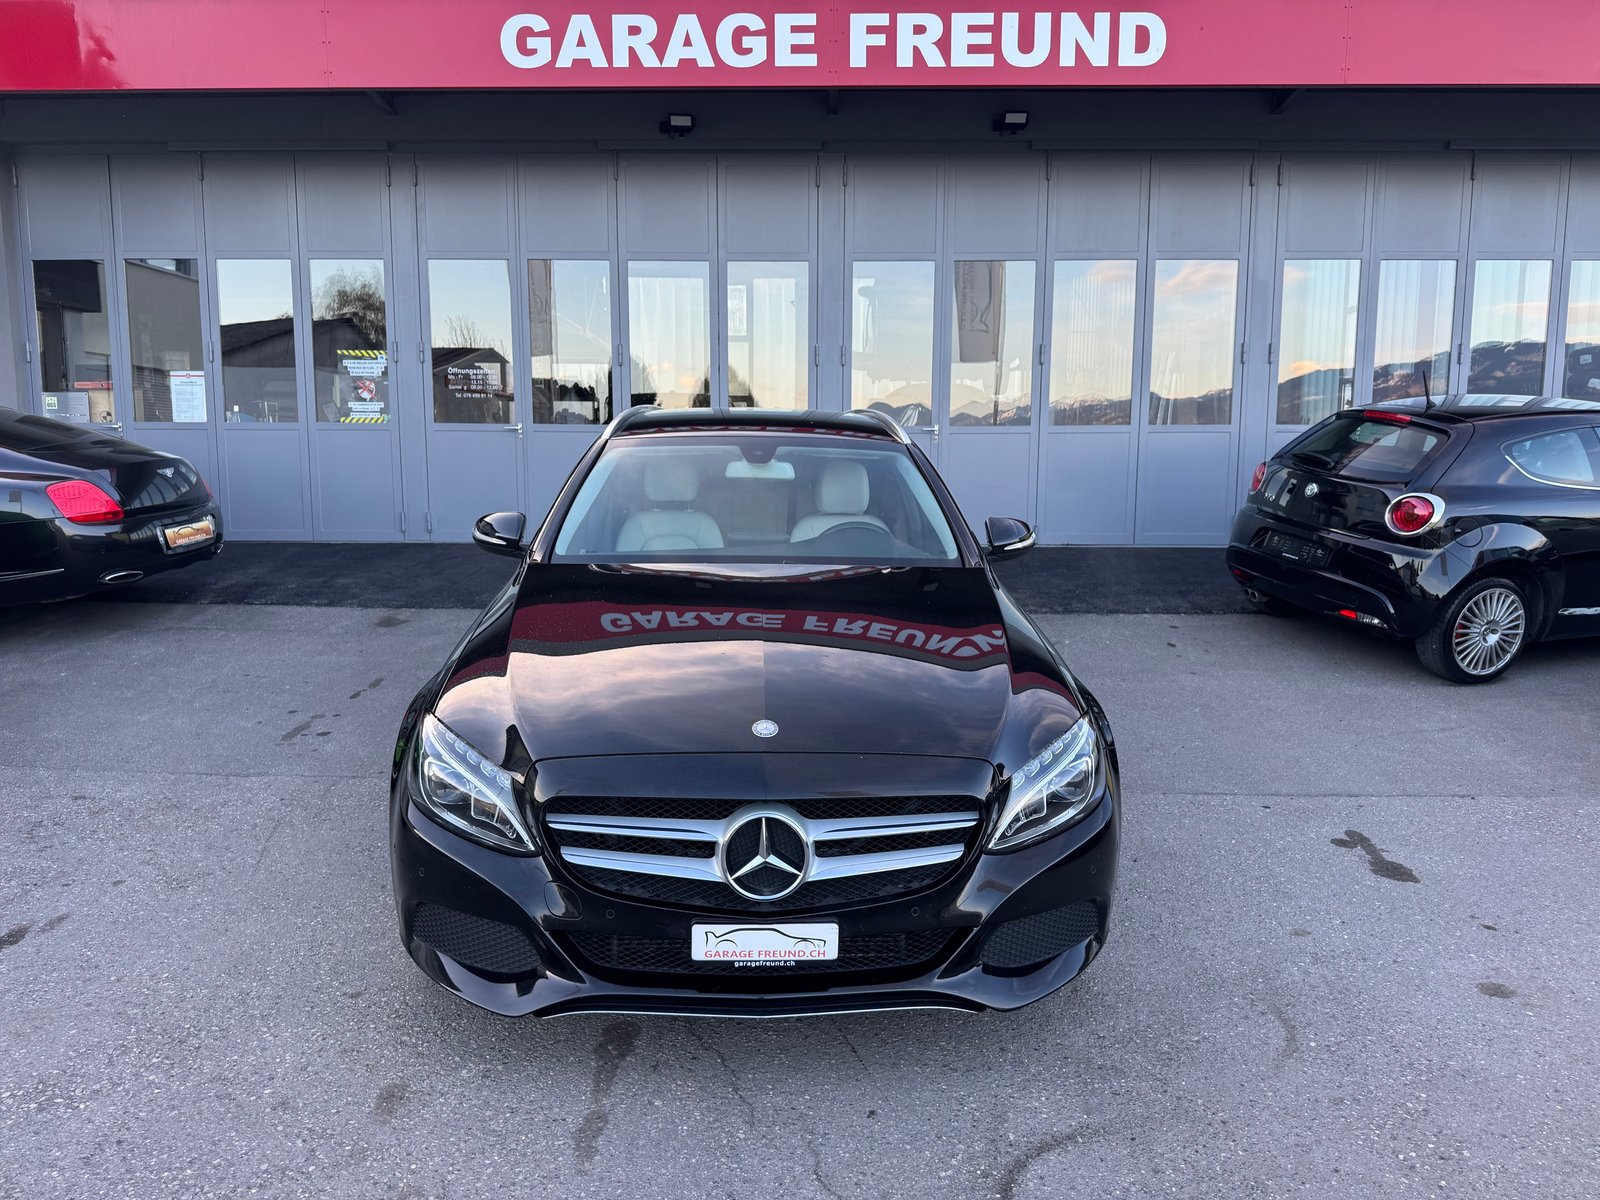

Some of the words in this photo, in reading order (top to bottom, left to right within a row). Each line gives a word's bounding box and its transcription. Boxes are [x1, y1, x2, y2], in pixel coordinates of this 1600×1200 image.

[500, 13, 818, 69] GARAGE
[849, 12, 1167, 68] FREUND
[448, 367, 498, 375] Öffnungszeiten:
[704, 950, 754, 958] GARAGE
[757, 950, 826, 958] FREUND.CH
[734, 960, 796, 968] garagefreund.ch
